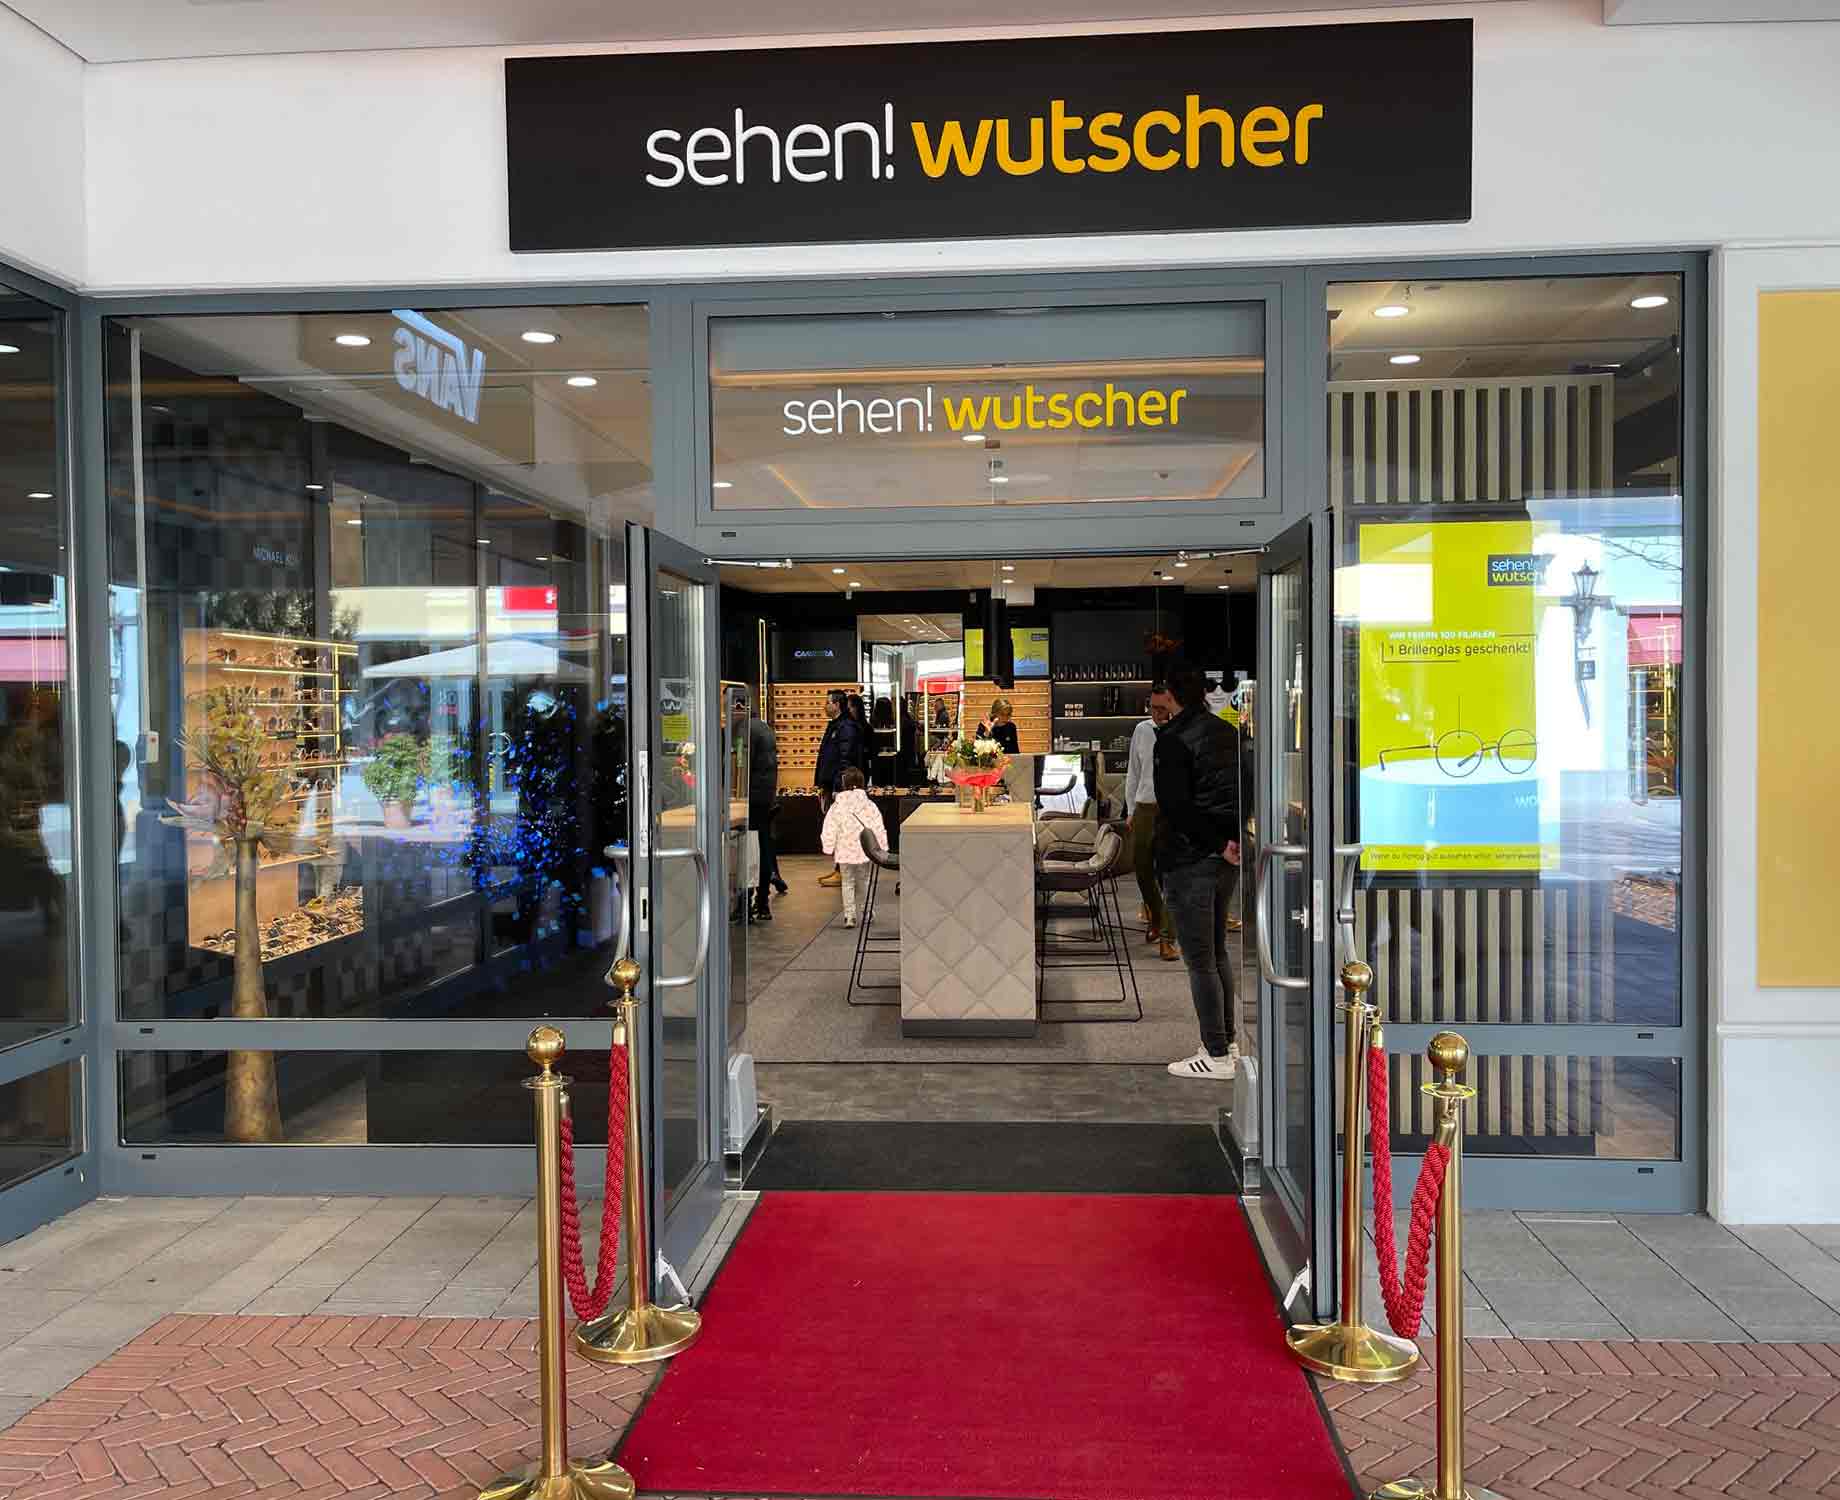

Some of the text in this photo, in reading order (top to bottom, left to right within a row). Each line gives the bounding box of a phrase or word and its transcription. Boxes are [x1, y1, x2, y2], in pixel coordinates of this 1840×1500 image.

[646, 95, 1323, 187] sehen! wutscher
[783, 383, 1185, 435] sehen! wutscher
[1491, 558, 1534, 572] sehen!
[1389, 645, 1394, 656] 1
[1399, 643, 1461, 657] Brillenglas
